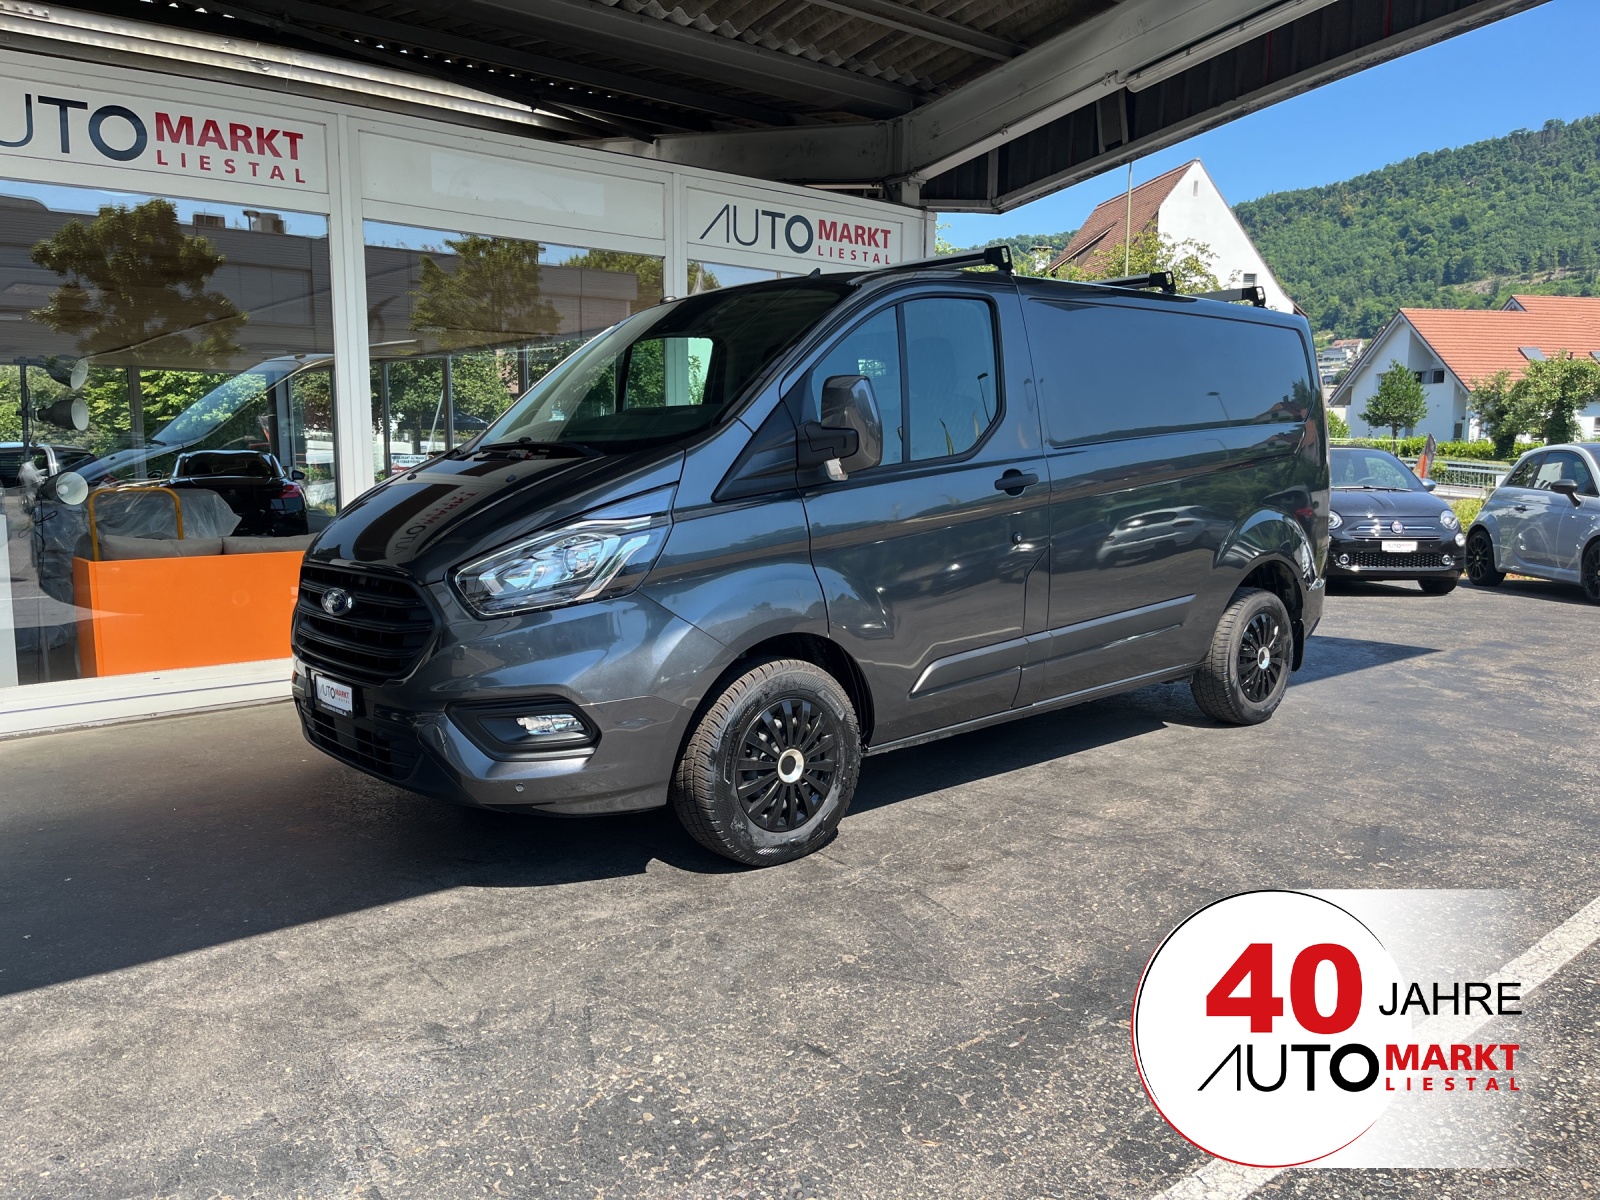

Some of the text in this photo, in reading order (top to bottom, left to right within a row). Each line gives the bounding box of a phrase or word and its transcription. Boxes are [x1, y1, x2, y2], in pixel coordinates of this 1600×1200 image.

[155, 111, 304, 160] MARKT
[156, 149, 306, 184] LIESTAL
[699, 204, 891, 254] AUTO MARKT
[817, 245, 891, 265] LIESTAL
[320, 683, 335, 699] AUTO
